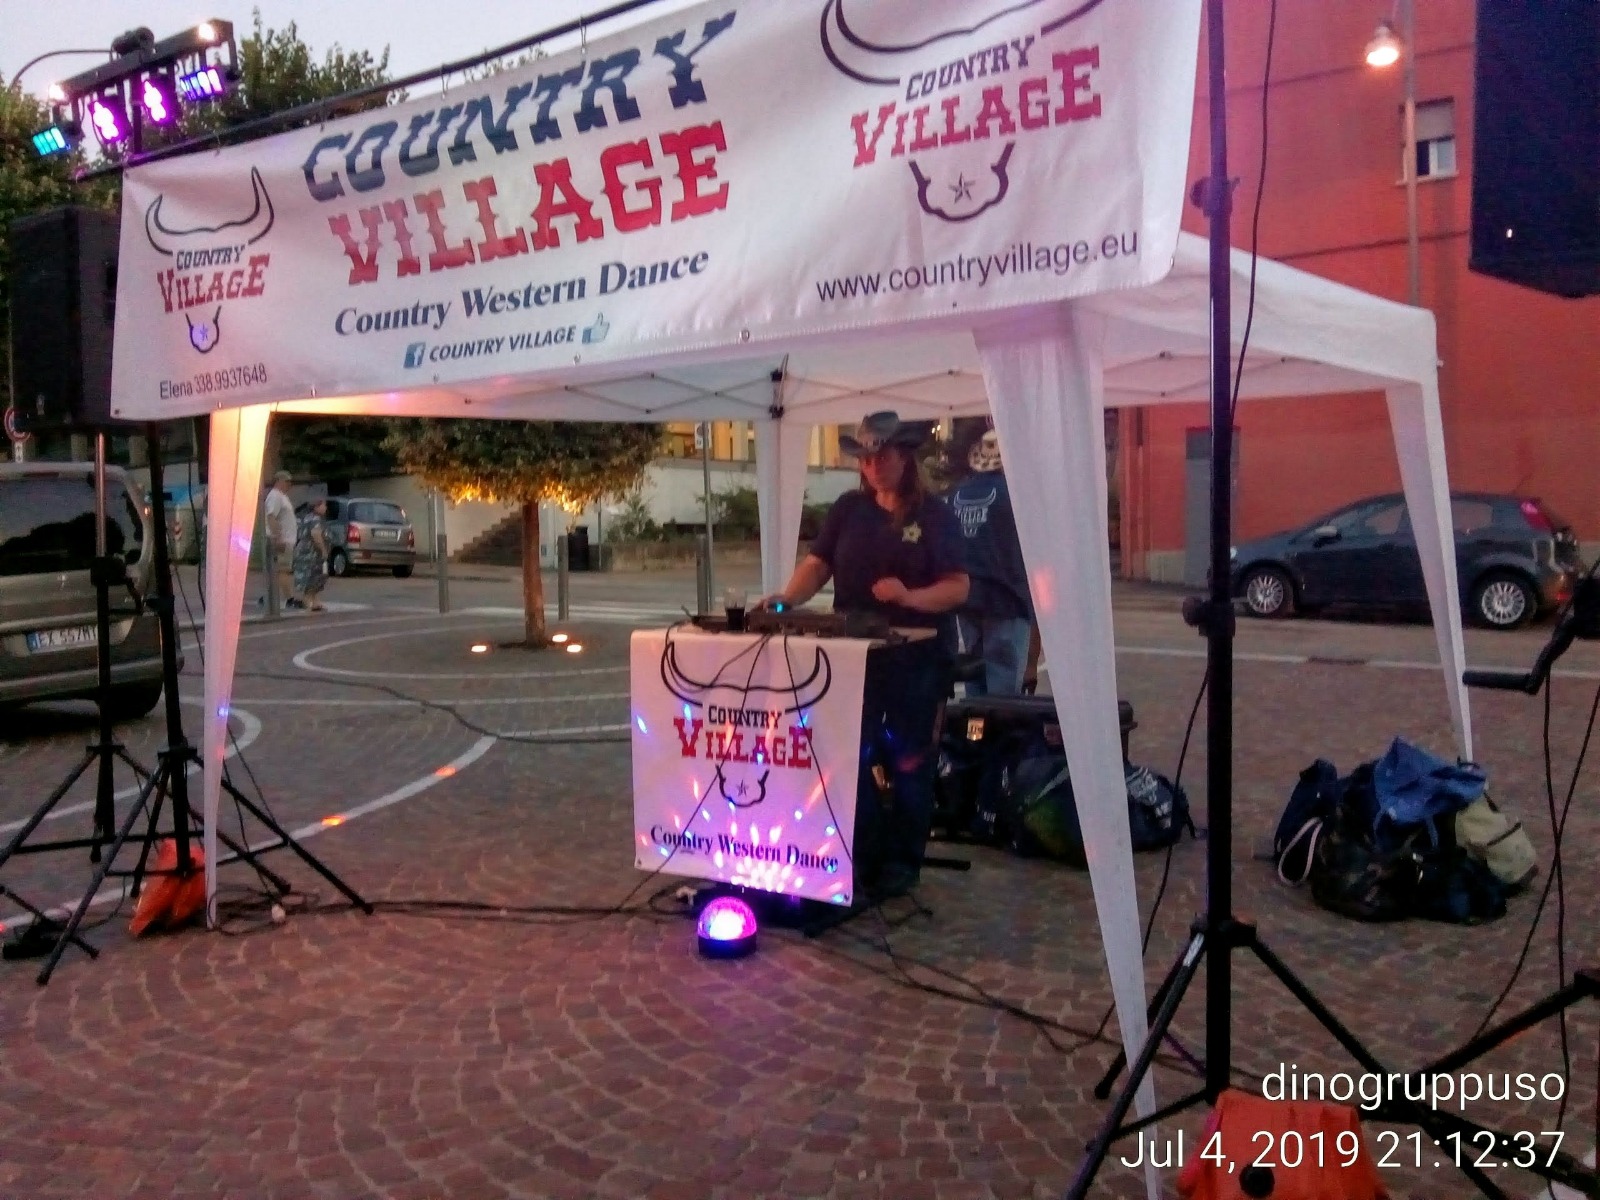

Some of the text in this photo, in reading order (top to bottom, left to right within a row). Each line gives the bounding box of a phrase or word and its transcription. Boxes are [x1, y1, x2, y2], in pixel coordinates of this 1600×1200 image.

[905, 35, 1034, 101] COUNTRY
[302, 10, 737, 201] COUNTRY
[850, 45, 1101, 167] VILLAGE
[328, 120, 730, 286] VILLAGE
[157, 253, 270, 313] VILLAGE
[176, 245, 245, 271] COUNTRY
[816, 231, 1138, 302] www.countryvillage.eu
[335, 250, 708, 336] Country Western Dance
[429, 335, 505, 362] COUNTRY
[509, 326, 576, 353] VILLAGE
[160, 363, 267, 400] Elena 338.9937648
[674, 716, 813, 769] VILLAGE
[708, 705, 782, 728] COUNTRY
[651, 824, 838, 873] Country Western Dance
